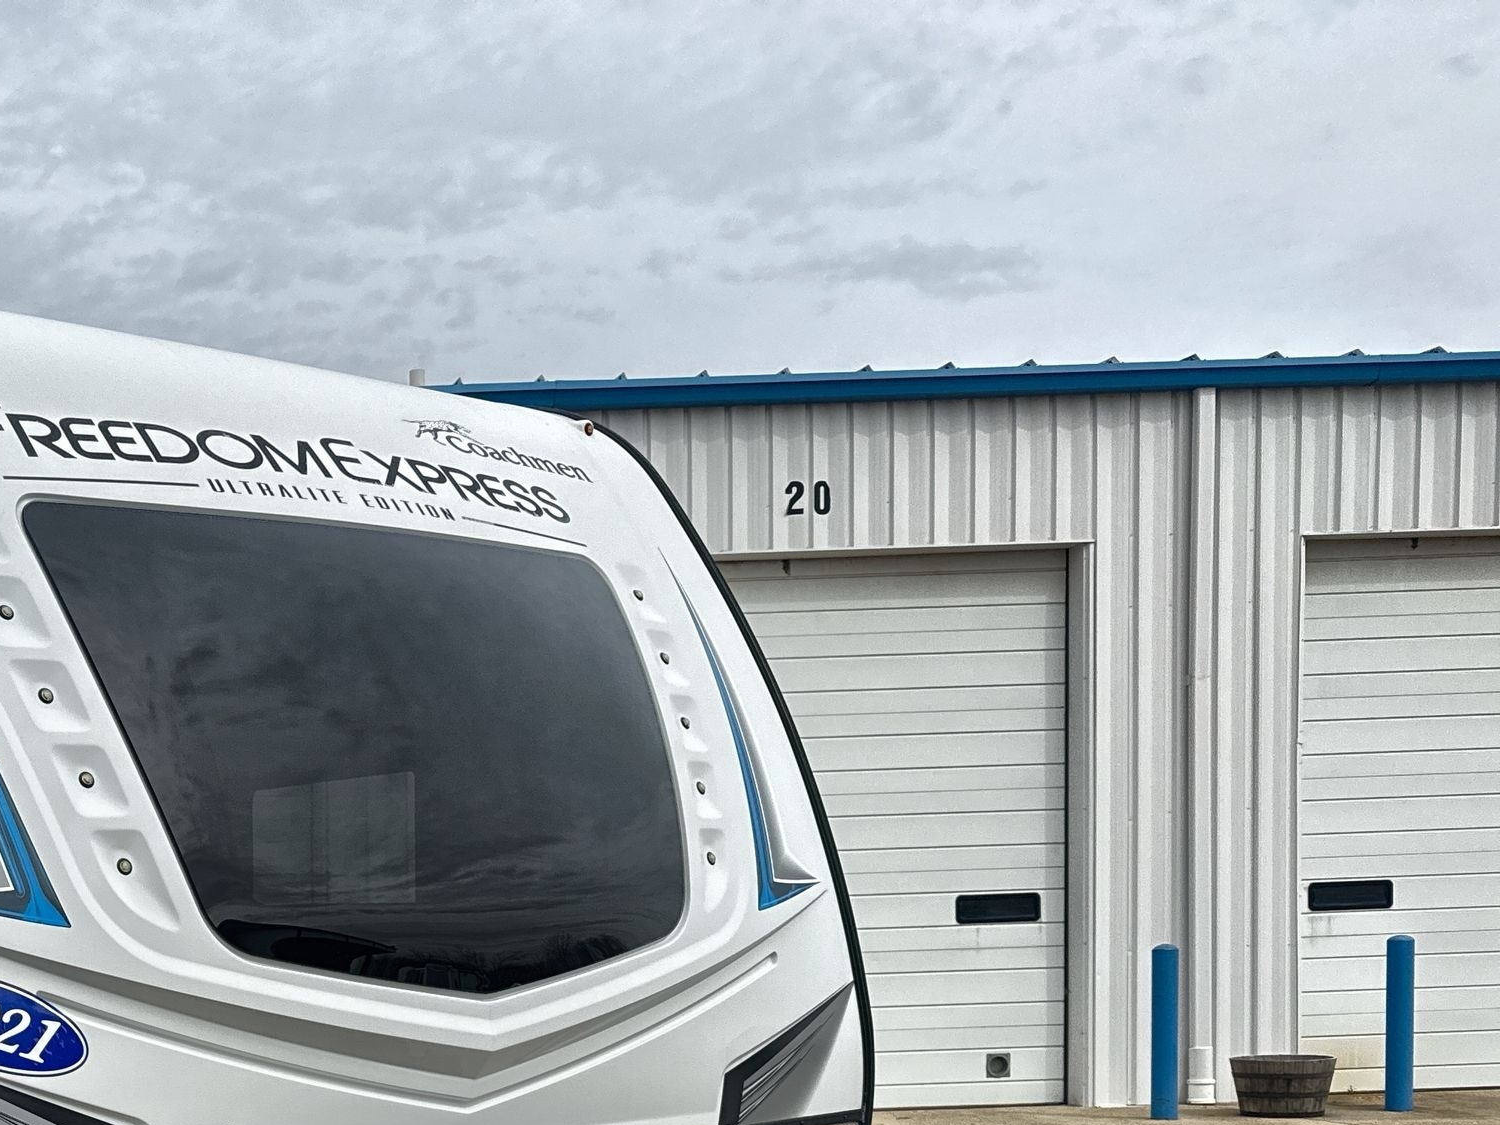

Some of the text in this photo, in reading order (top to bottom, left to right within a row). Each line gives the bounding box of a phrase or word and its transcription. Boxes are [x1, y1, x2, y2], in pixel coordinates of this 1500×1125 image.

[445, 434, 594, 484] Coachmen
[206, 478, 456, 522] ULTRALITE EDITION
[784, 480, 831, 516] 20
